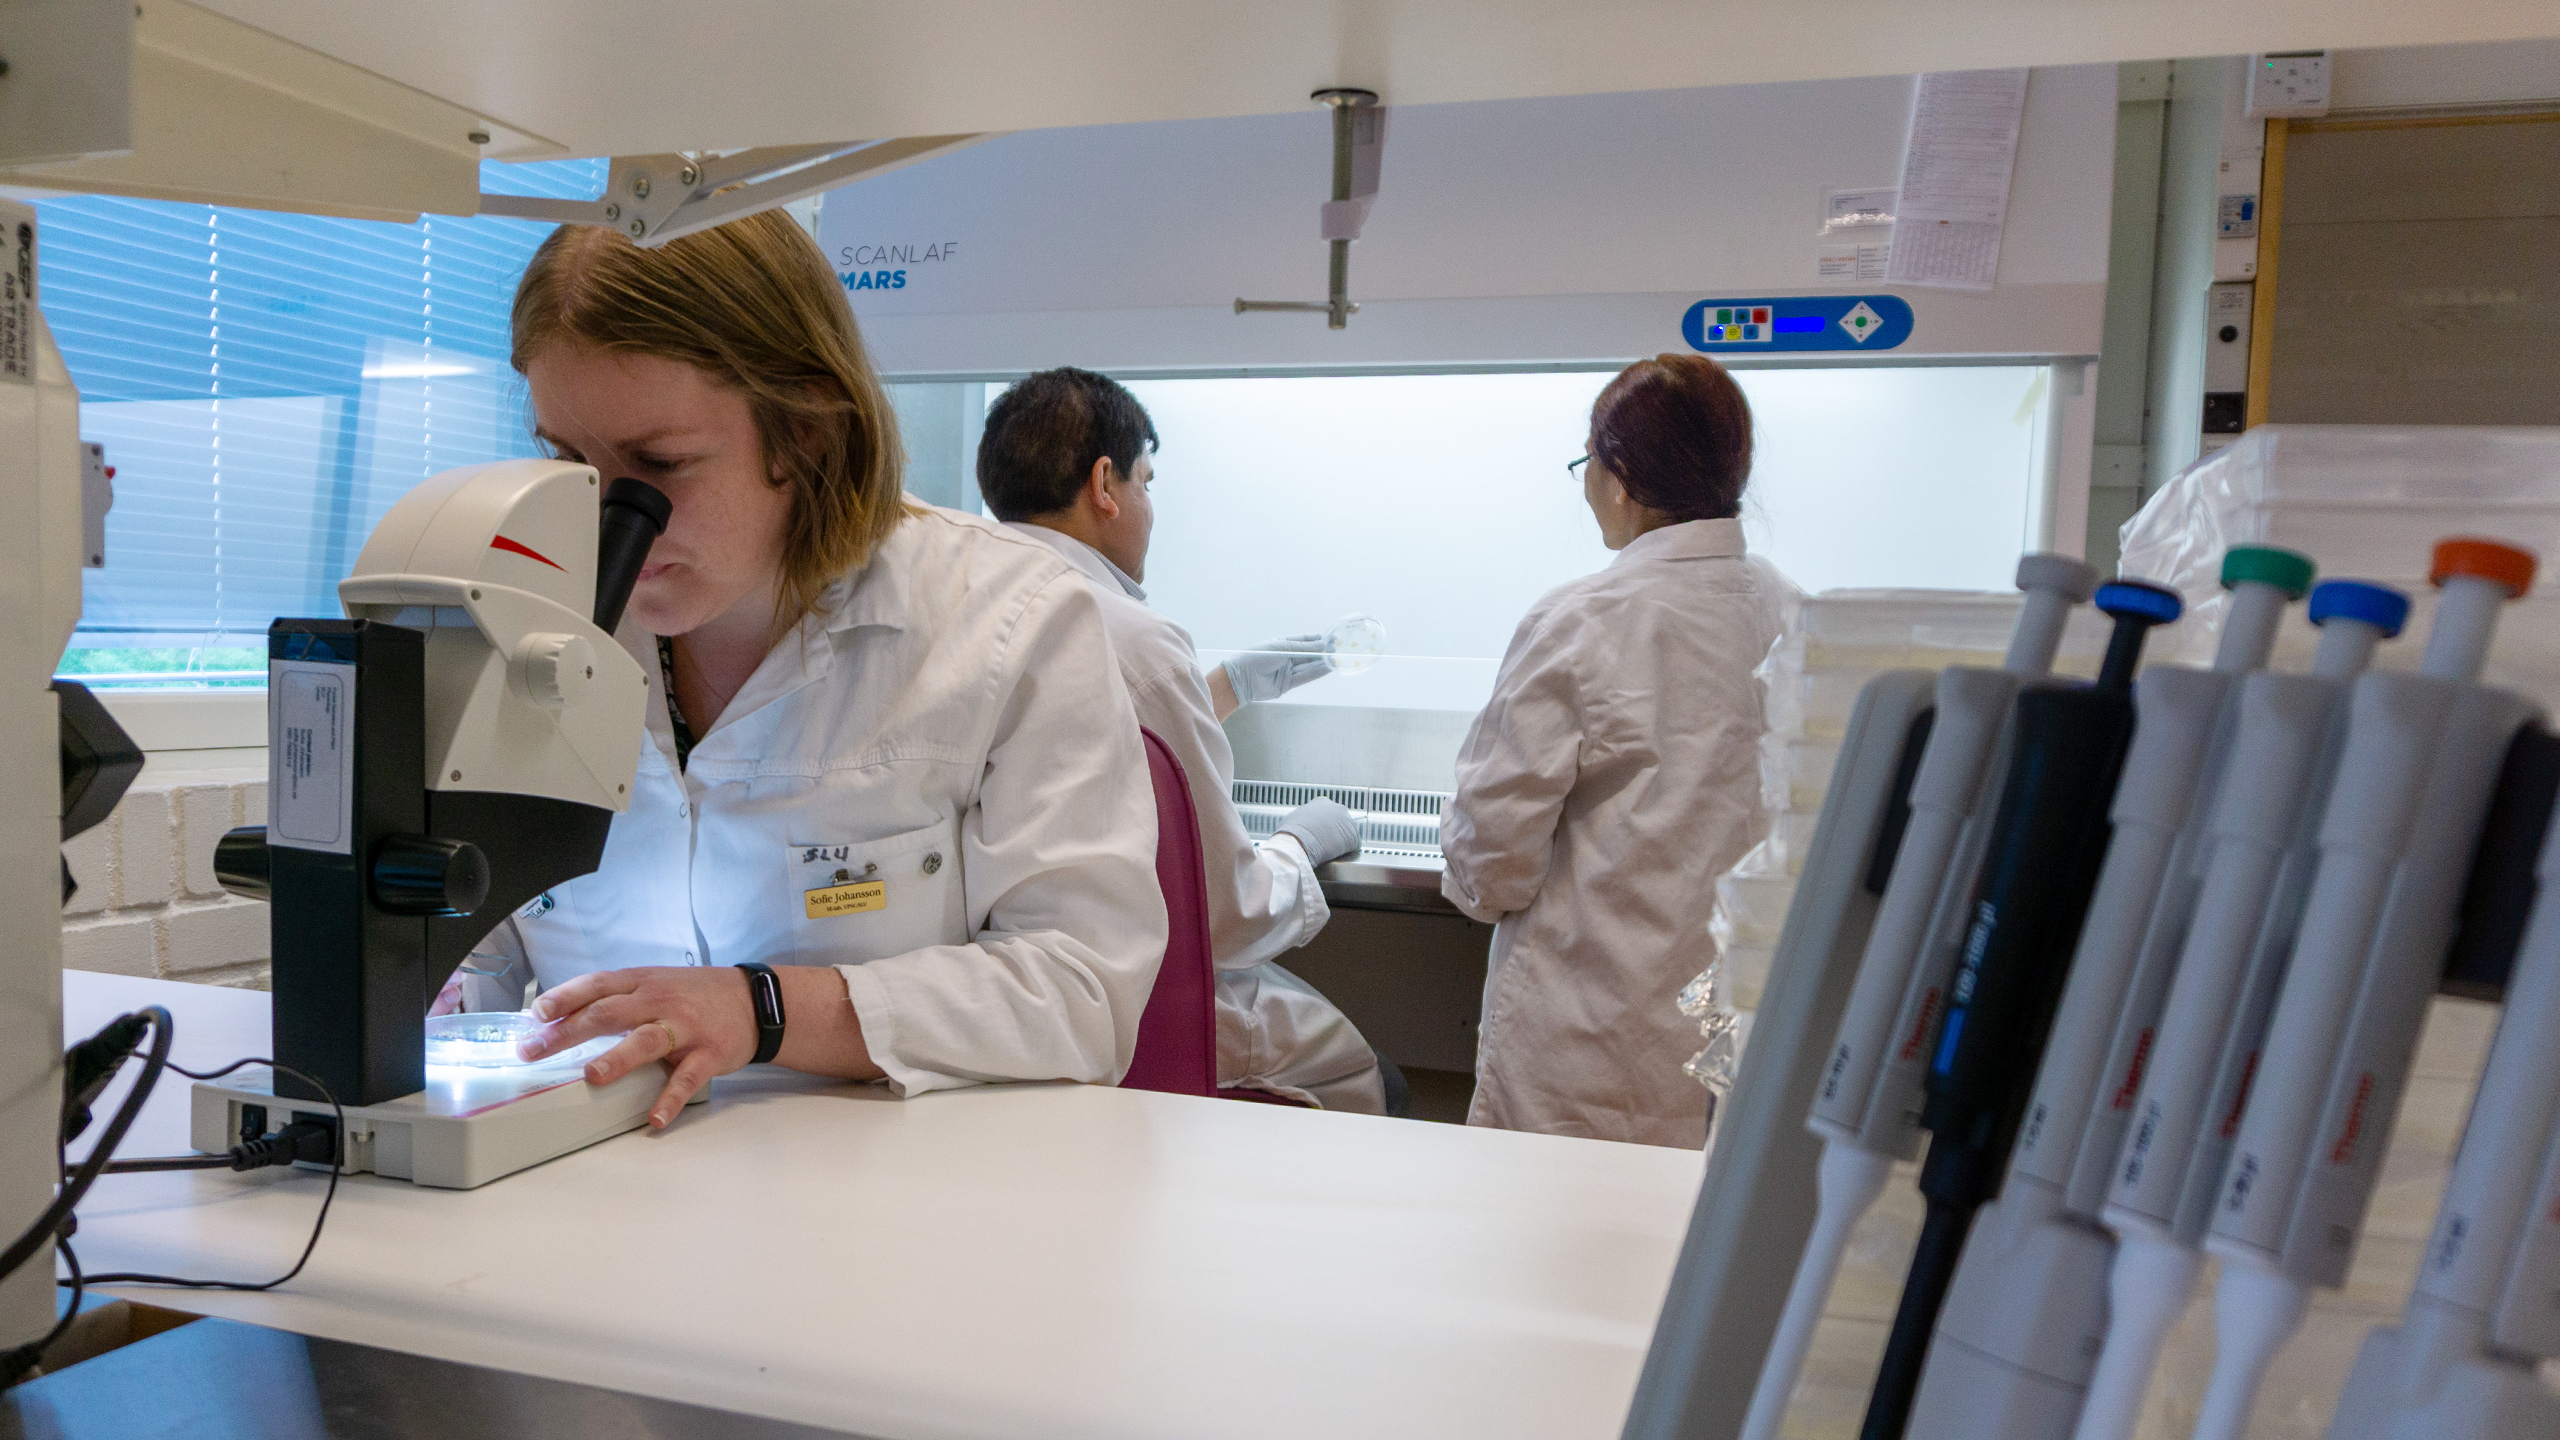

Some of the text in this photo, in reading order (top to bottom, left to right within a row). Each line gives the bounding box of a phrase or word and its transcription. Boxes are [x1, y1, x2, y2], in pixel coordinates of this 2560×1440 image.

[840, 242, 958, 266] SCANLAF
[838, 270, 907, 290] MARS
[5, 271, 17, 374] ARTRADE
[803, 846, 849, 863] SLU
[810, 889, 881, 905] Sofie Johansson
[2112, 1026, 2154, 1110] Thermo
